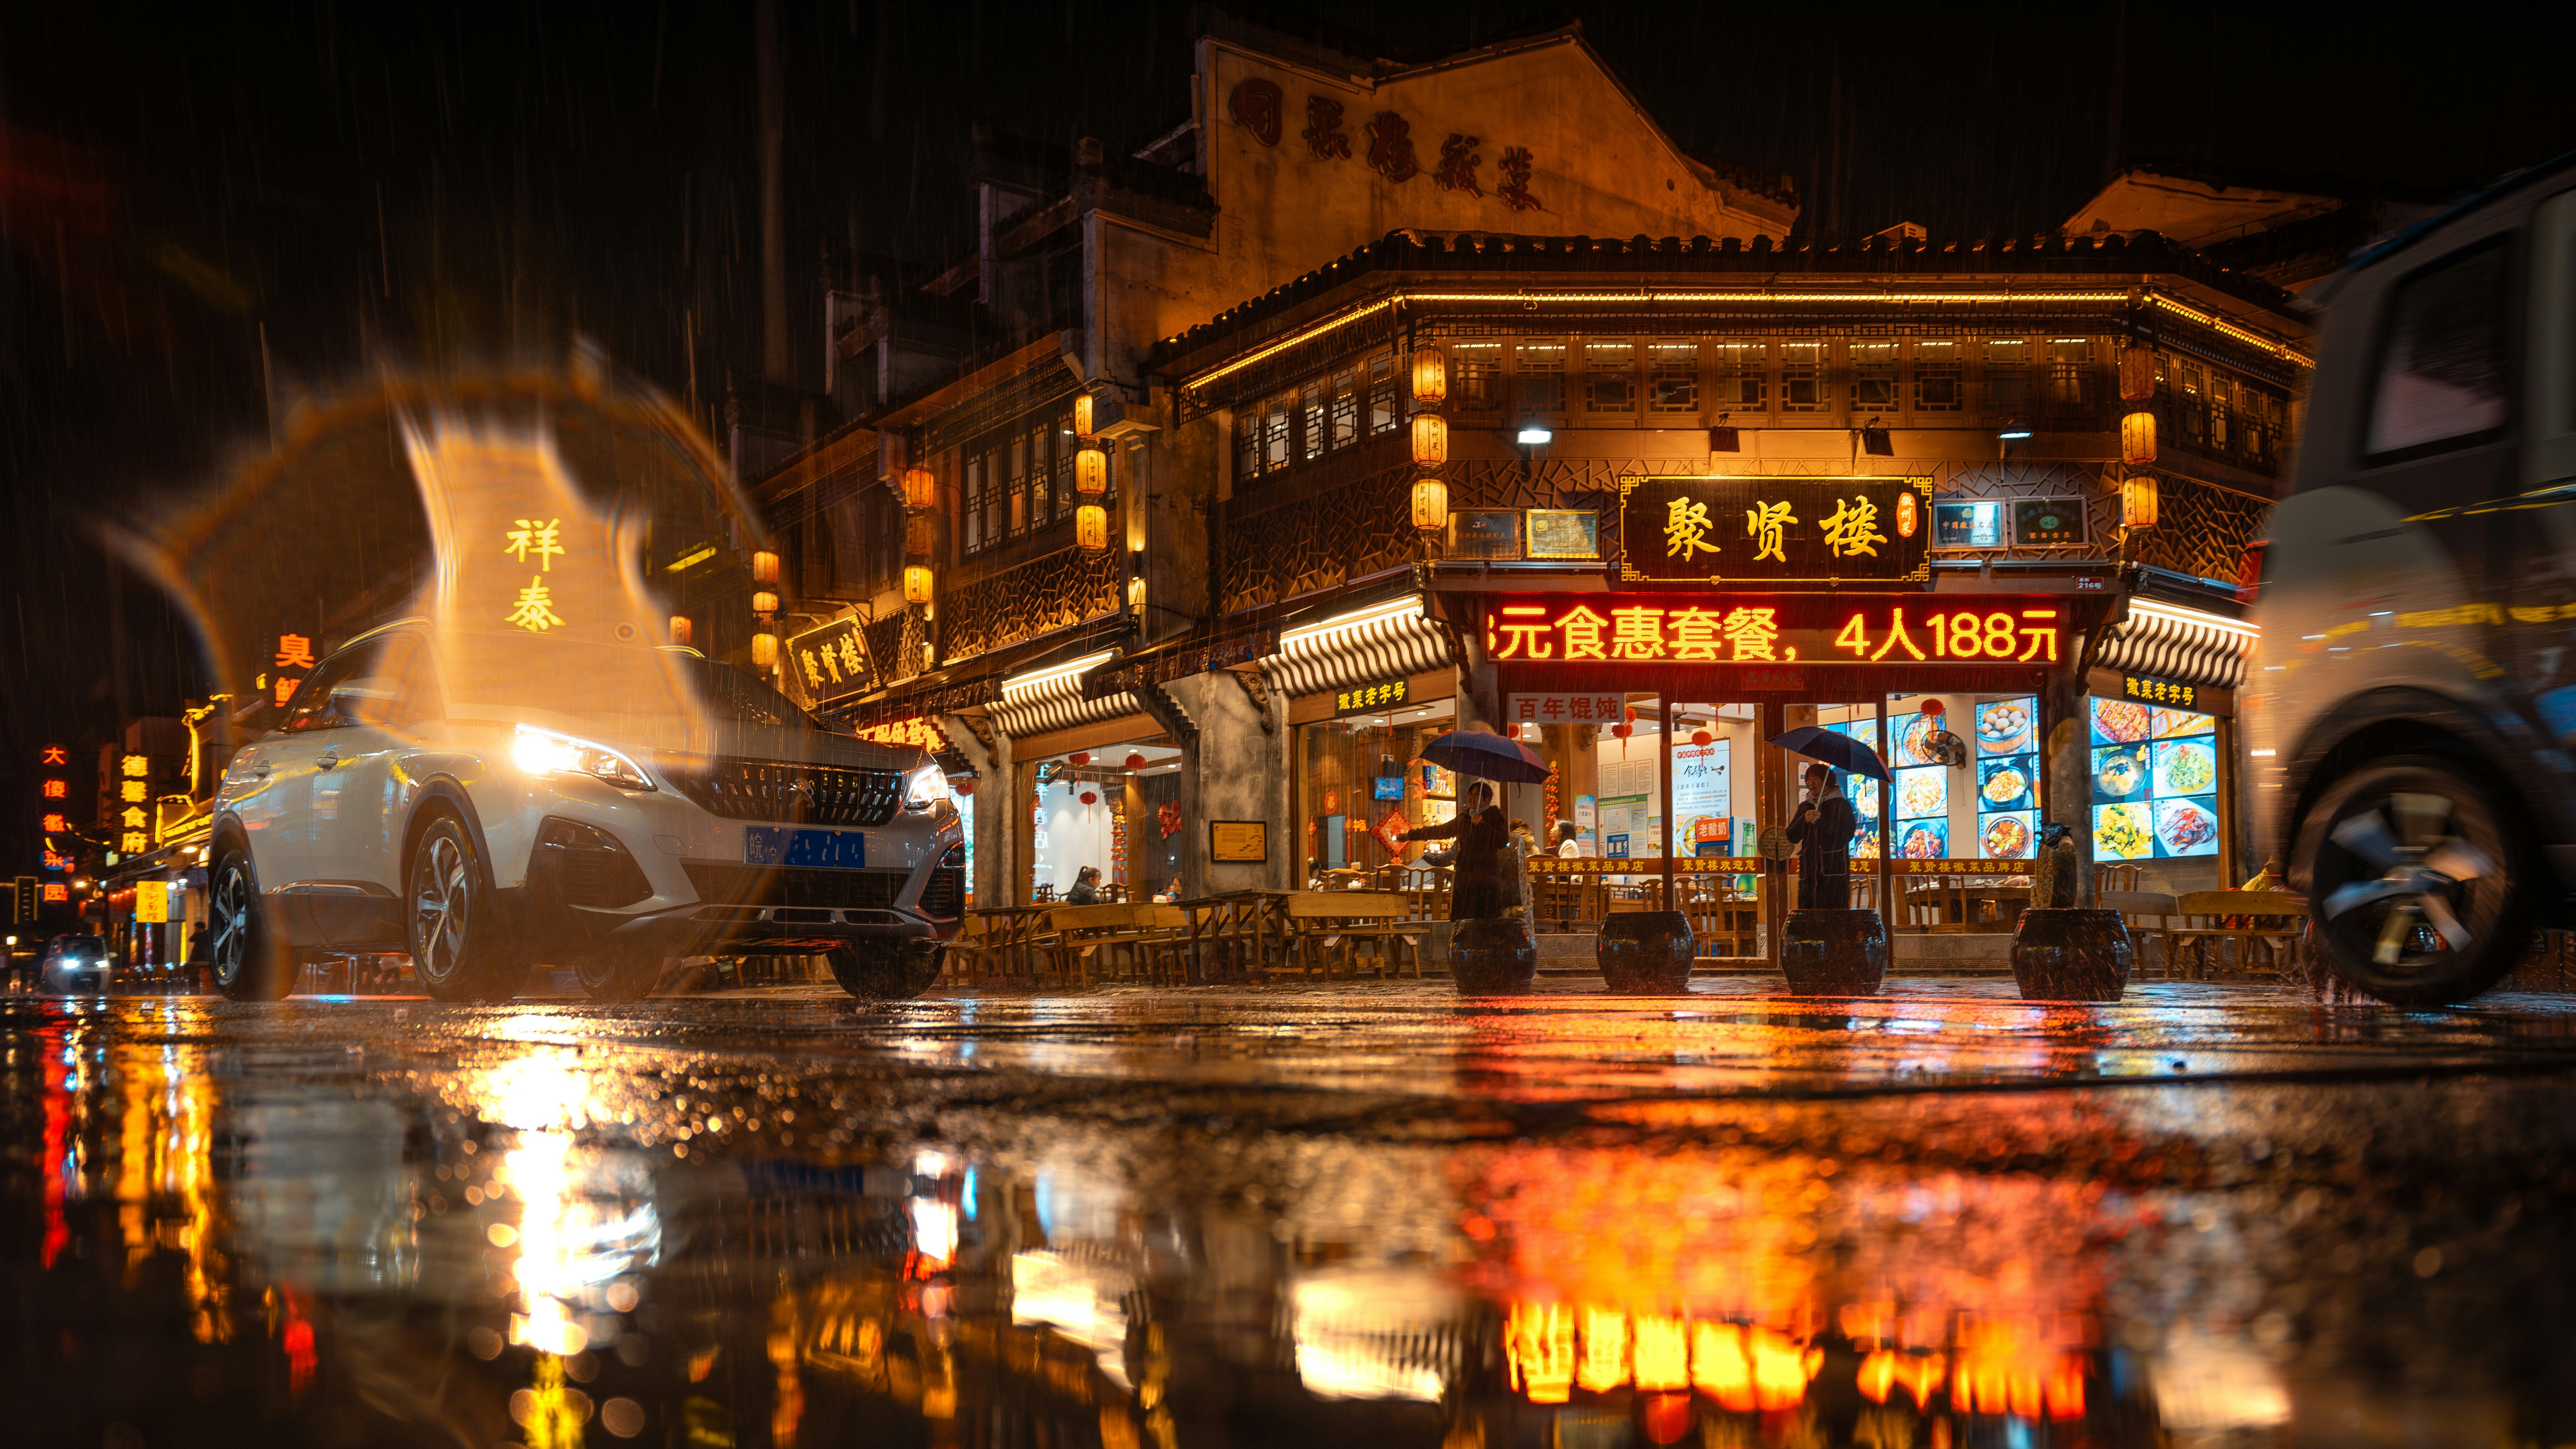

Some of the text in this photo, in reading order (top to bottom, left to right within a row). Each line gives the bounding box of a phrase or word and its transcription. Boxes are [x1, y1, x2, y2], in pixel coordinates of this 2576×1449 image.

[1419, 485, 1427, 516] 聚贤楼
[1900, 495, 1914, 535] 徽州菜
[1664, 495, 1887, 563] 聚贤楼
[503, 518, 566, 632] 祥泰
[1488, 606, 2057, 662] 元食惠套餐， 4人188元
[1339, 681, 1406, 711] 徽菜老字号
[2126, 677, 2194, 706] 徽菜老字号
[1515, 696, 1619, 720] 百年馄饨
[121, 755, 149, 853] 德馨食府
[1699, 822, 1727, 837] 老酸奶
[1527, 860, 1645, 873] 聚贤楼徽菜品牌店
[1682, 859, 1756, 872] 聚贤楼欢迎您
[1908, 861, 2025, 873] 聚贤楼徽菜品牌店
